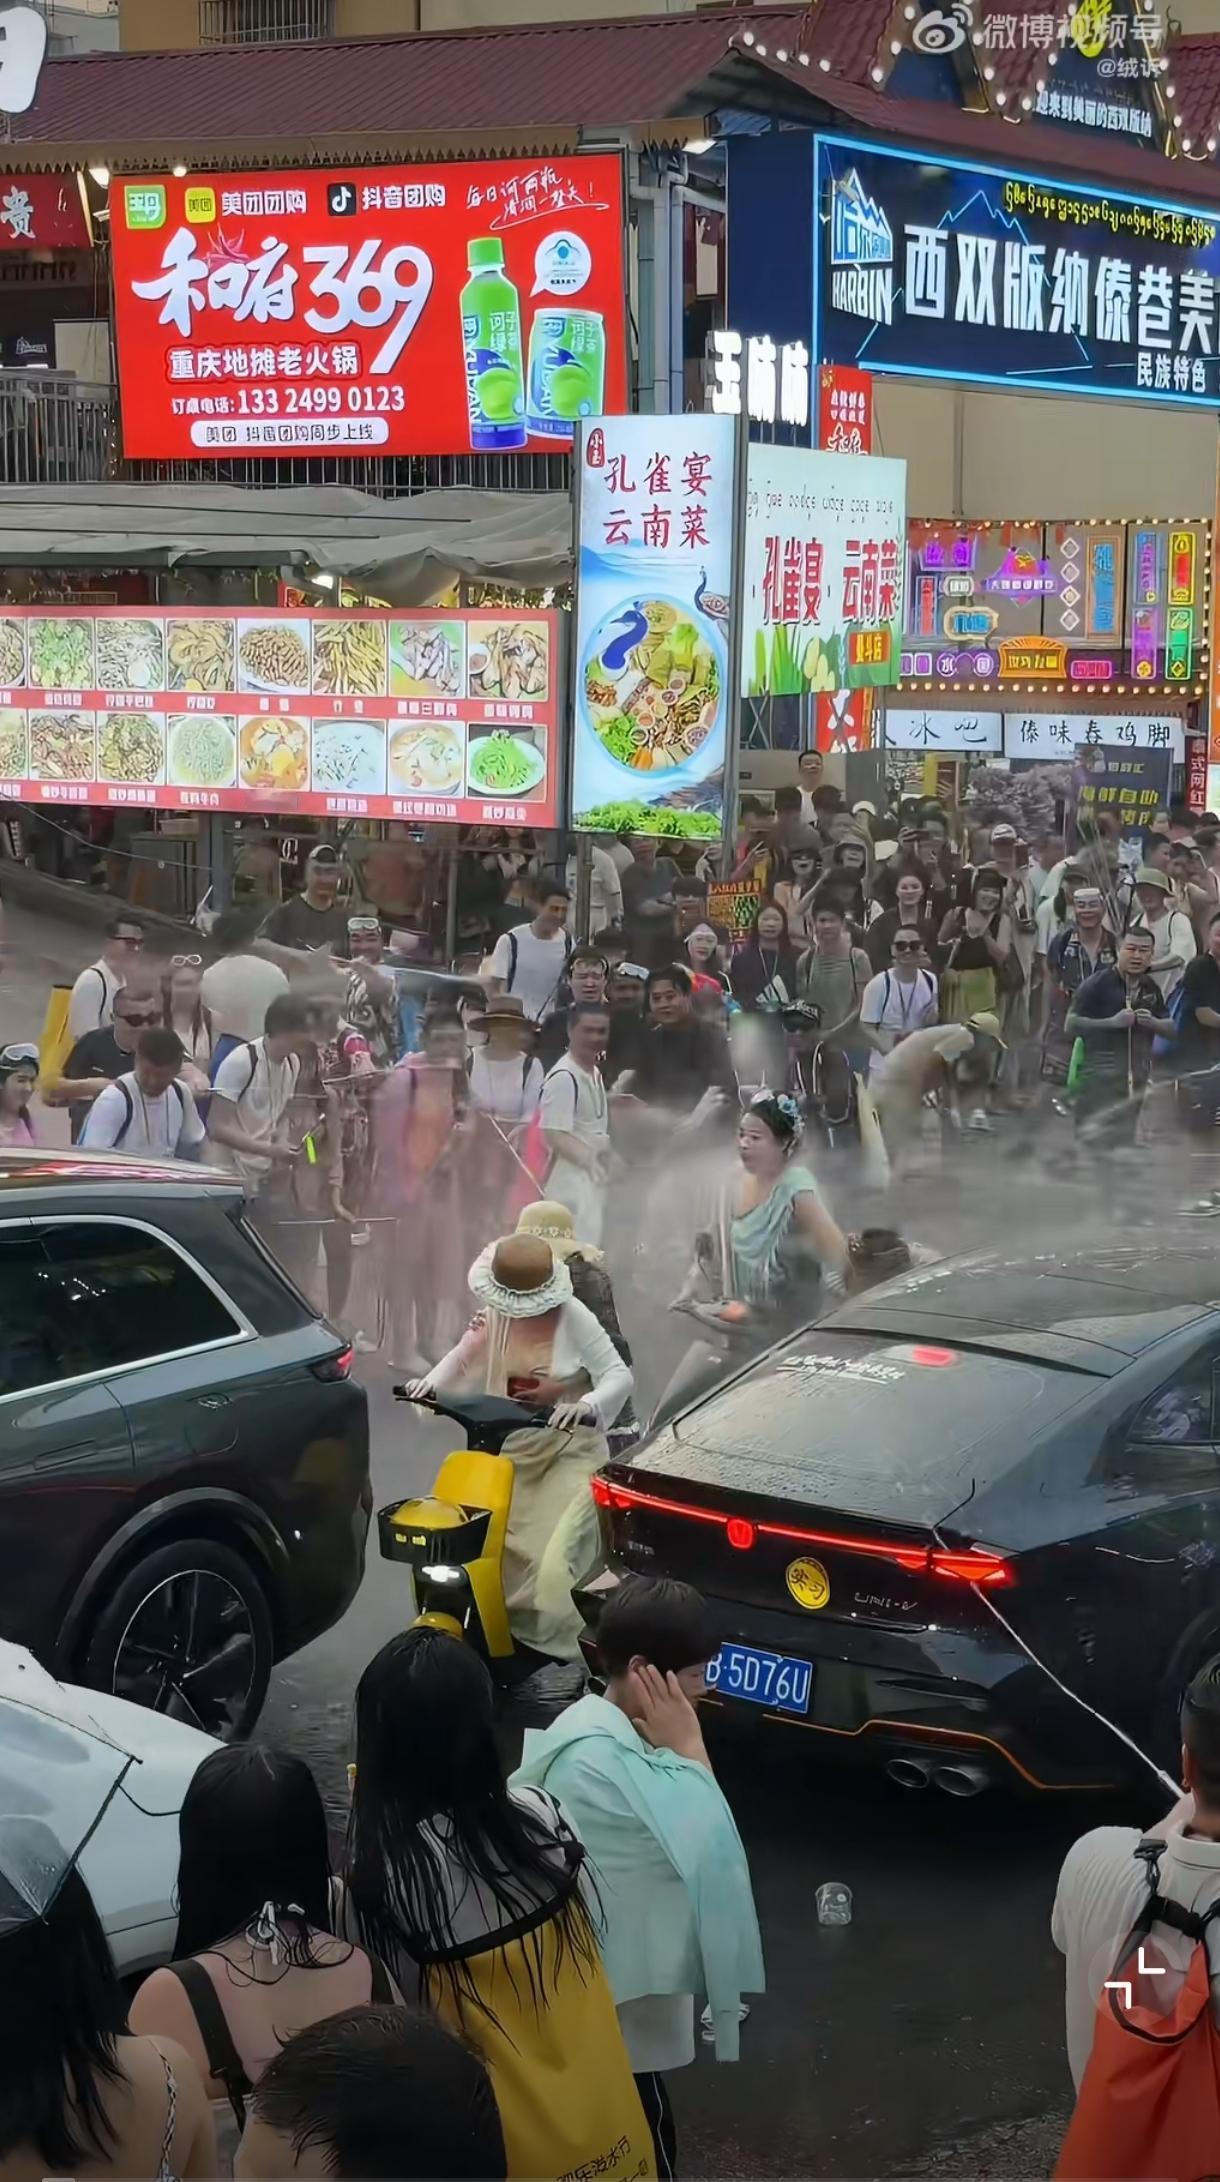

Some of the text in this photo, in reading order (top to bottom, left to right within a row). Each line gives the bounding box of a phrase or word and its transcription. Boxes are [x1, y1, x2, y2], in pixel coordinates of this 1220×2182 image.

[0, 185, 36, 239] 贵
[221, 190, 307, 216] 美团团购
[362, 184, 446, 210] 抖音团购
[832, 268, 892, 325] HARBIN
[169, 346, 359, 379] 重庆地摊老火锅
[1137, 352, 1206, 393] 民族特色
[238, 389, 279, 415] 133
[285, 387, 341, 414] 2499
[348, 386, 405, 412] 0123
[604, 451, 713, 497] 孔雀宴
[603, 503, 711, 550] 云南菜
[762, 535, 824, 626] 孔雀宴
[841, 539, 897, 625] 云南菜
[884, 711, 987, 746] 冰吧
